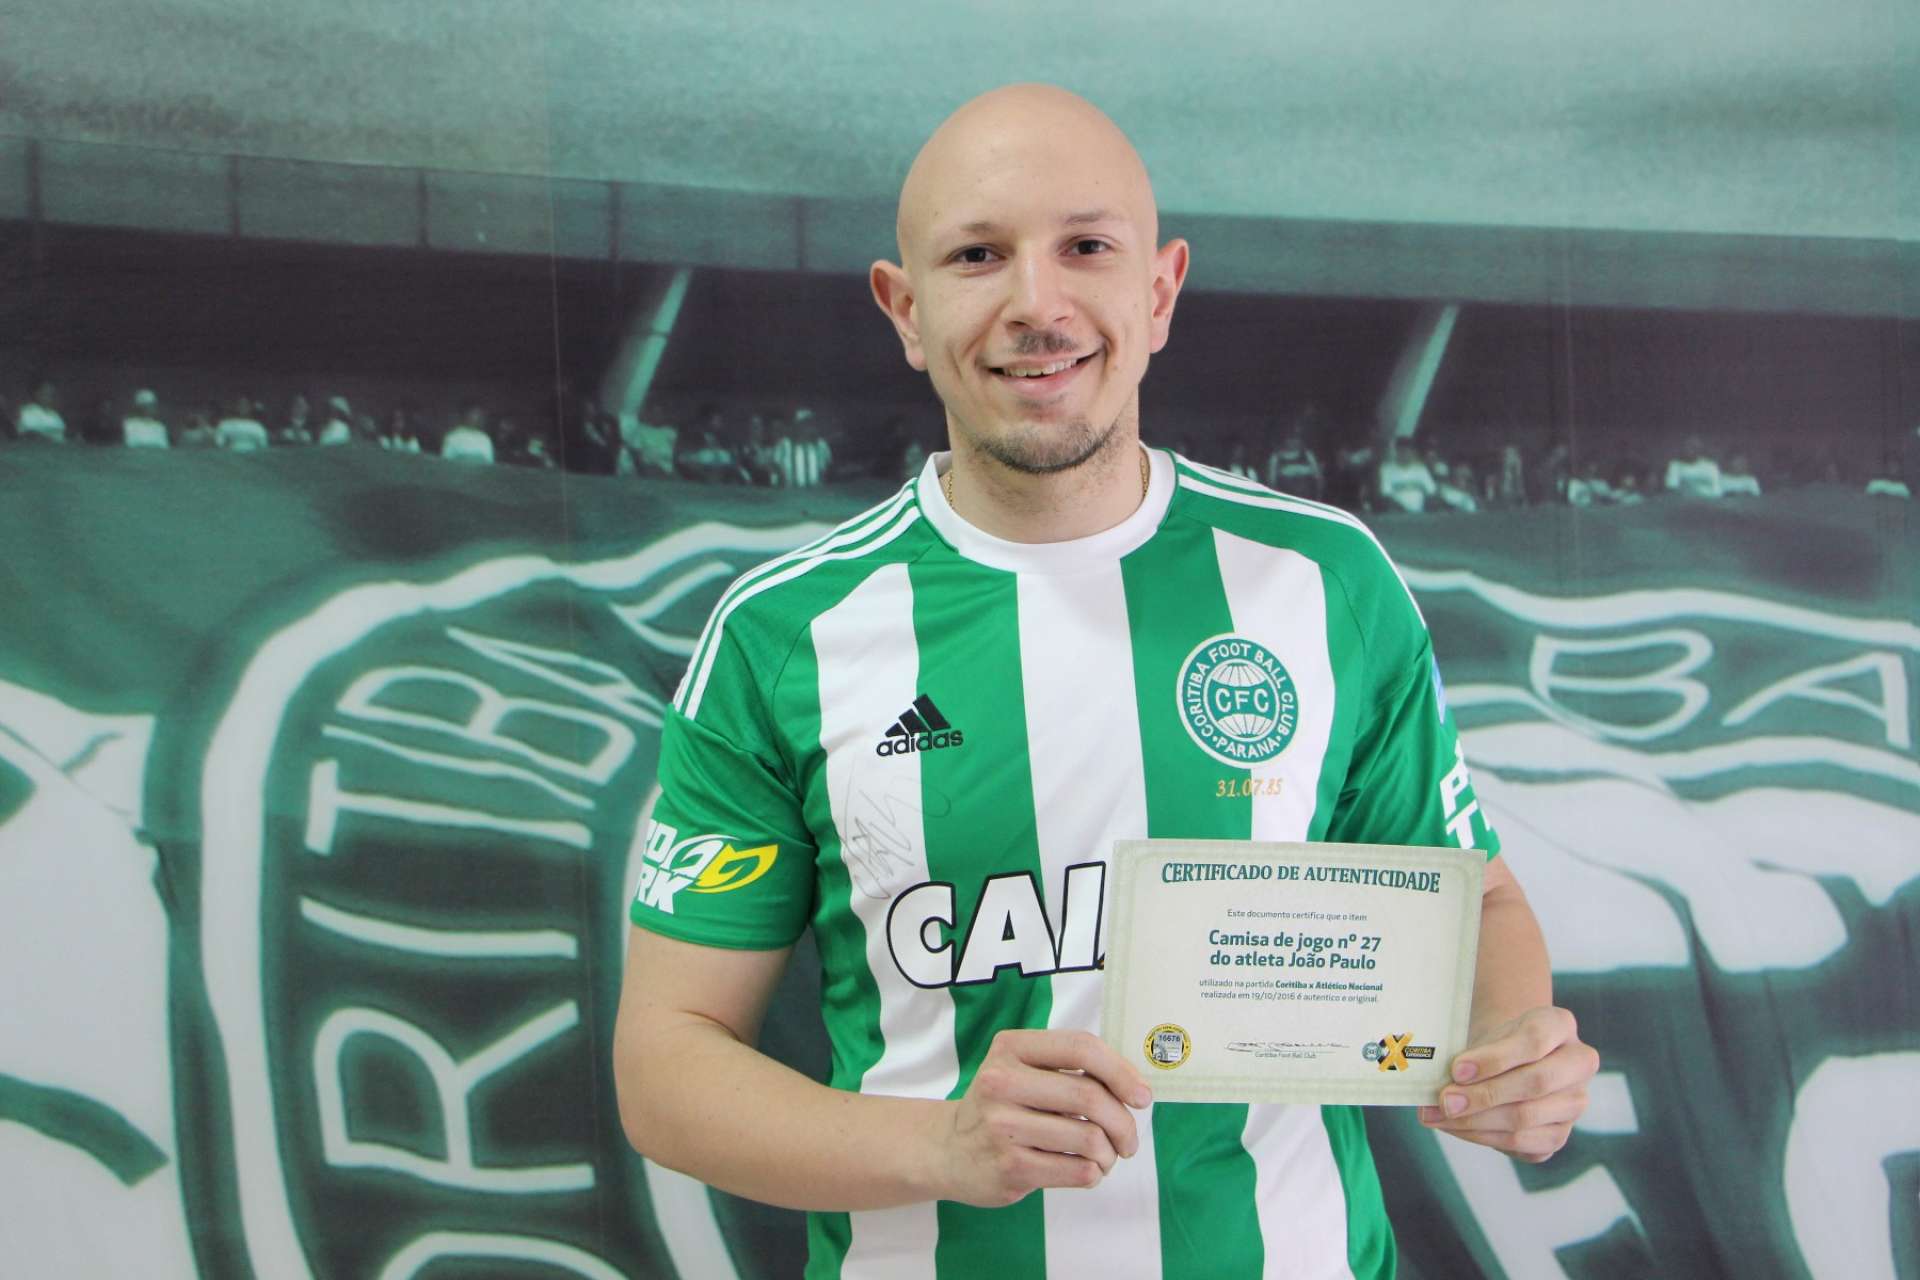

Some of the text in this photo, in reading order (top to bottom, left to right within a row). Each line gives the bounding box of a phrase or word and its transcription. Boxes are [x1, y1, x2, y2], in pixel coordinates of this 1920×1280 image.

[1187, 642, 1295, 737] CORITIBA FOOT BALL CLUB
[1215, 687, 1270, 713] CFC
[875, 727, 965, 757] adidas
[1161, 862, 1441, 893] CERTIFICADO DE AUTENTICIDADE
[886, 861, 1106, 989] CAI
[1227, 908, 1246, 918] Este
[1246, 909, 1290, 919] documento
[1292, 911, 1325, 920] certifica
[1326, 913, 1341, 922] que
[1348, 912, 1368, 921] item
[1209, 929, 1382, 953] Camisa de jogo nº 27
[1210, 949, 1376, 970] do atleta João Paulo
[1200, 990, 1236, 999] realizada
[1235, 980, 1245, 988] na
[1245, 979, 1274, 990] partida
[1275, 979, 1308, 989] Coritiba
[1315, 980, 1347, 991] Atlético
[1348, 981, 1384, 991] Nacional
